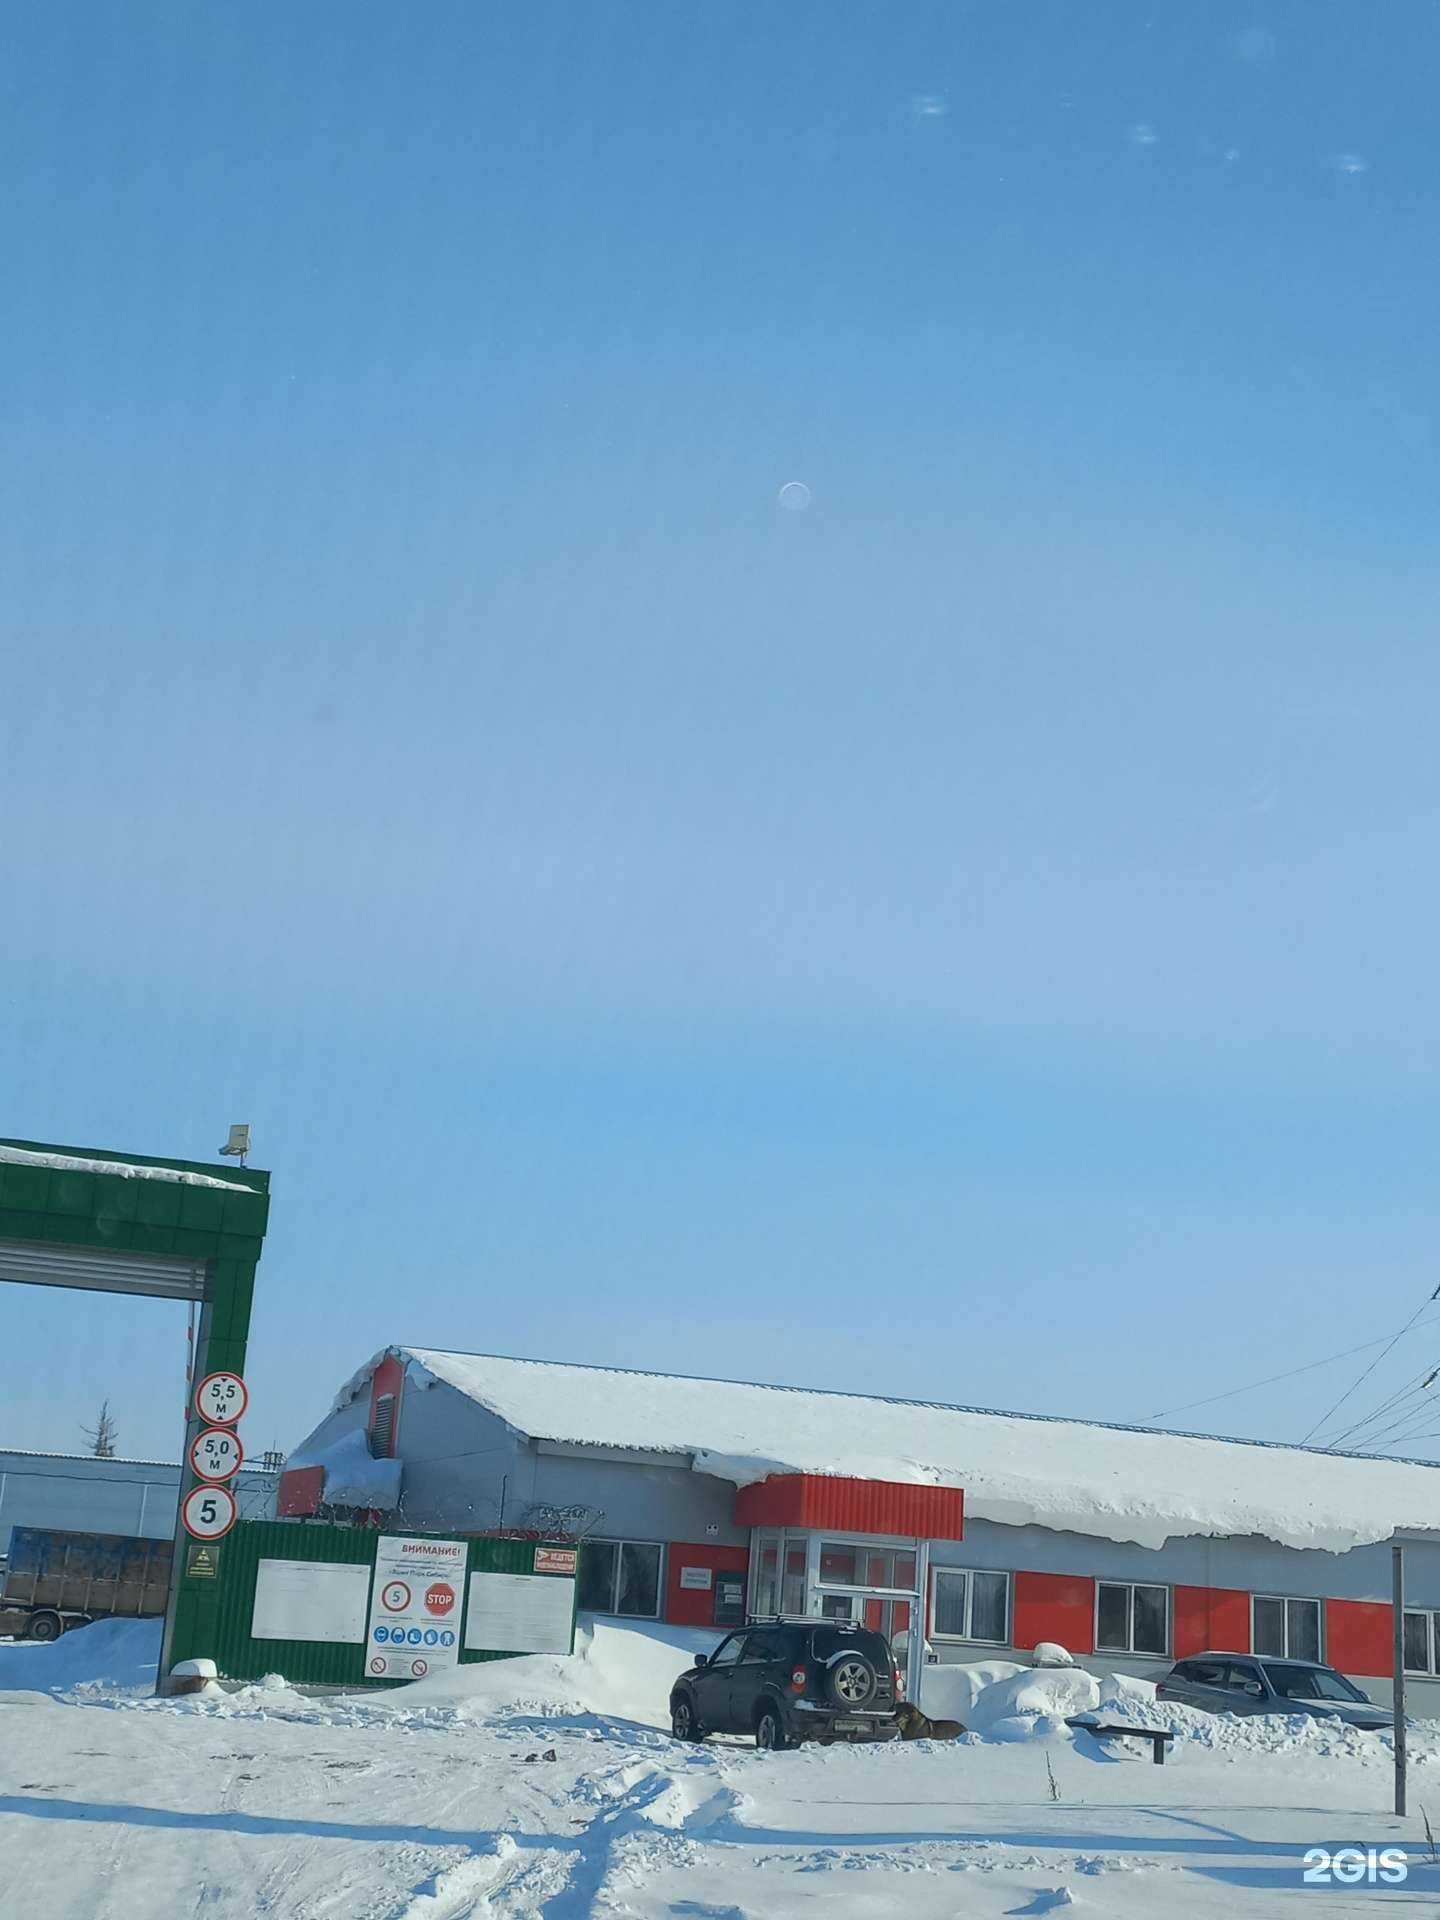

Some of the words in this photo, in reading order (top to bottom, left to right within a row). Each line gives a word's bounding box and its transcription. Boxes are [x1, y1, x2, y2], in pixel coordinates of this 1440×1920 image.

[211, 1384, 236, 1401] 5,5
[205, 1440, 230, 1457] 5,0
[200, 1500, 217, 1524] 5
[401, 1544, 461, 1557] ВНИМАНИЕ!
[392, 1591, 401, 1603] 5
[427, 1593, 452, 1605] STOP
